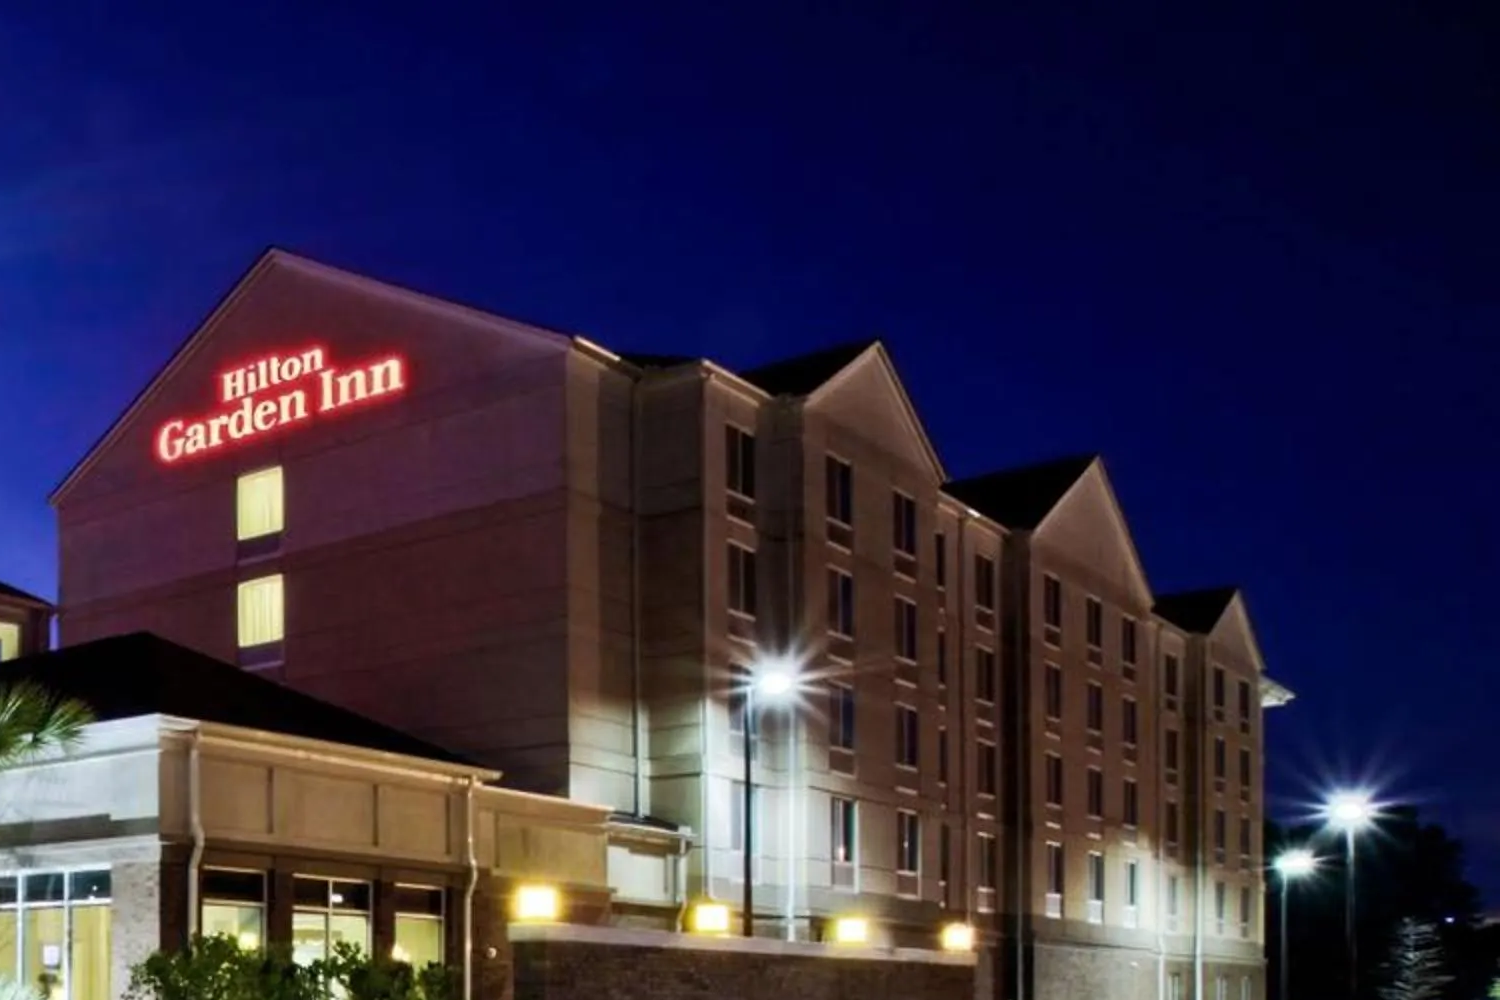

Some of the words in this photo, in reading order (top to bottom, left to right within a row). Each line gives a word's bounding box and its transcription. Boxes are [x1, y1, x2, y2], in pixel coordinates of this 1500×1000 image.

[158, 388, 308, 462] Garden
[318, 357, 405, 412] Inn
[222, 347, 324, 402] Hilton
